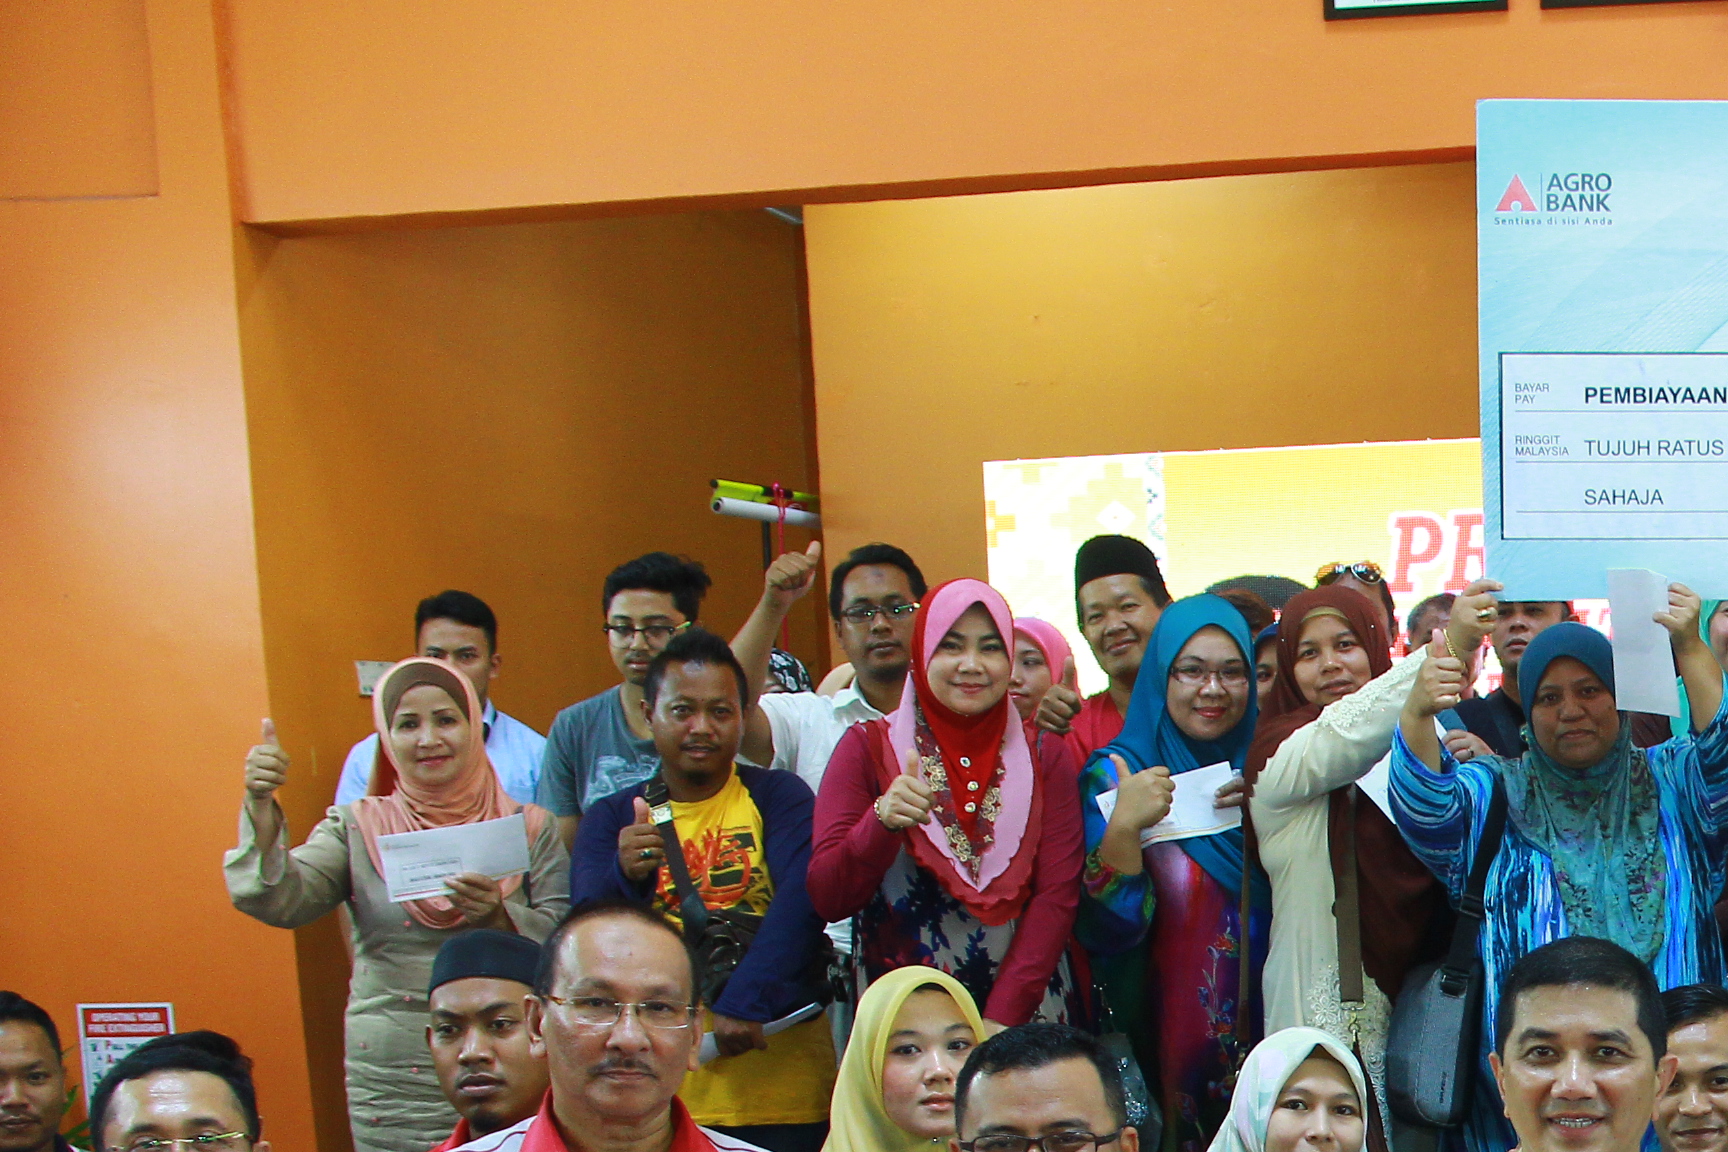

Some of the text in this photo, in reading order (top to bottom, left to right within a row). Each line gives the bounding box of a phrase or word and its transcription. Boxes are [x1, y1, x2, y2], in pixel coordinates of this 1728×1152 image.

[1547, 173, 1612, 192] AGRO
[1547, 194, 1610, 211] BANK
[1495, 217, 1612, 225] Sentiasa di sisi Anda
[1515, 383, 1549, 392] BAYAR
[1515, 395, 1535, 404] PAY
[1585, 387, 1726, 403] PEMBIAYAAN
[1515, 435, 1560, 445] RINGGIT
[1516, 446, 1569, 455] MALAYSIA
[1584, 440, 1650, 456] TUJUH
[1658, 440, 1723, 455] RATUS
[1585, 489, 1663, 505] SAHAJA
